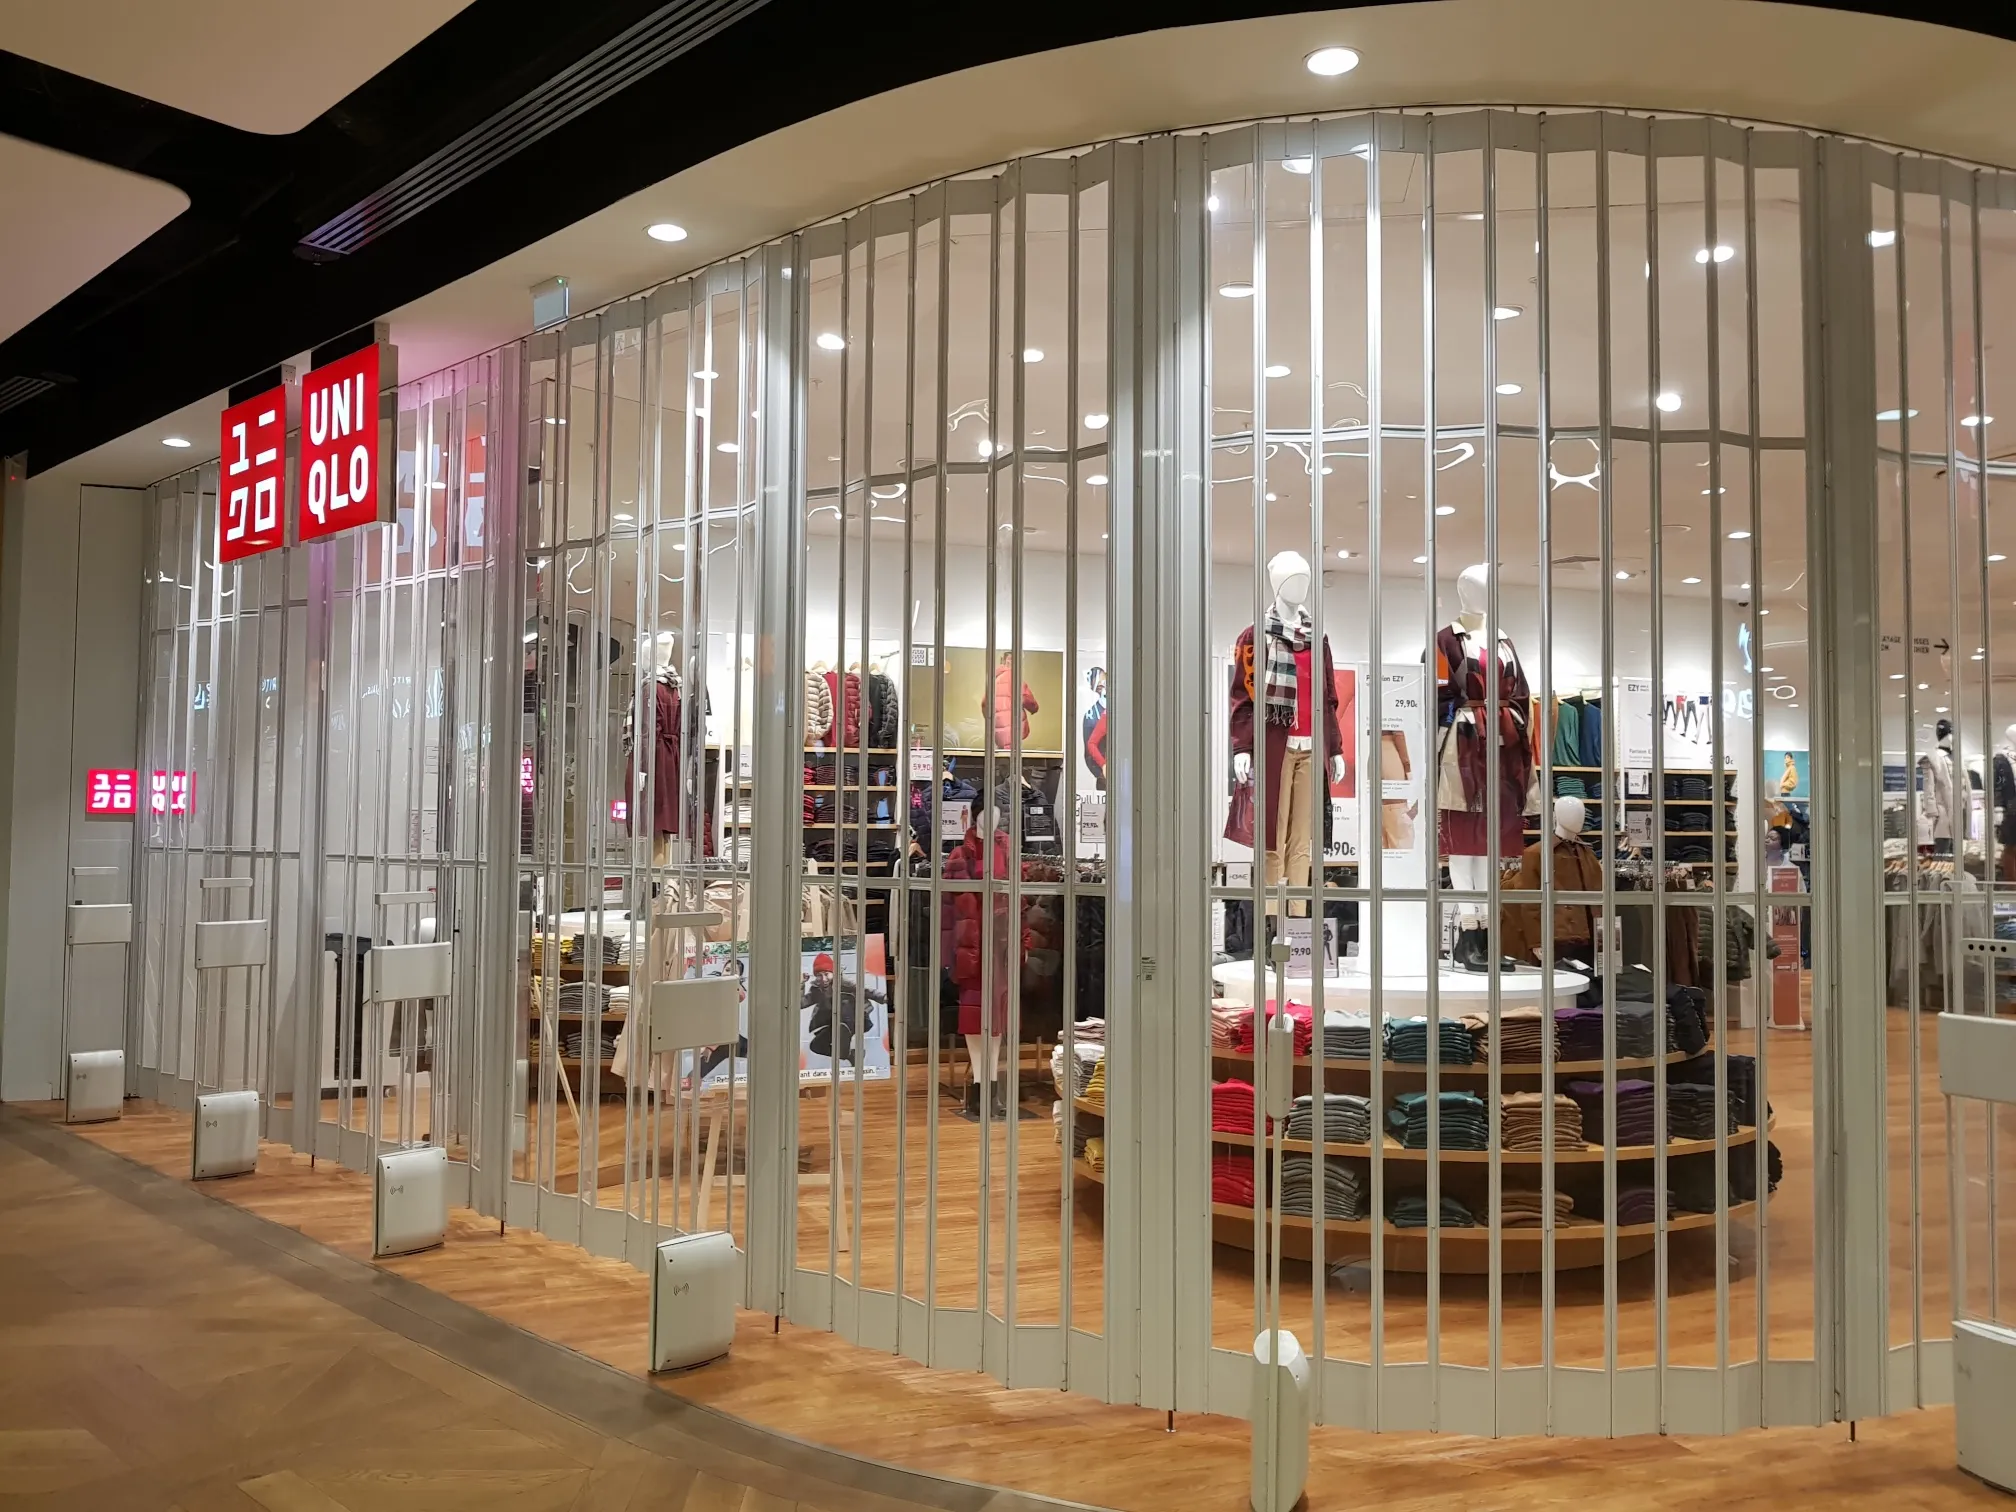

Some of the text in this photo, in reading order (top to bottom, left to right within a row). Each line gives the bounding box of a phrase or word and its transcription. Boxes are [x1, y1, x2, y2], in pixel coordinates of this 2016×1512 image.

[310, 372, 364, 446] UNI
[229, 409, 277, 476] ユニ
[226, 476, 277, 542] クロ
[308, 444, 369, 525] QLO
[1628, 684, 1640, 692] EZY
[91, 791, 132, 809] クロ
[93, 773, 132, 791] ユニ
